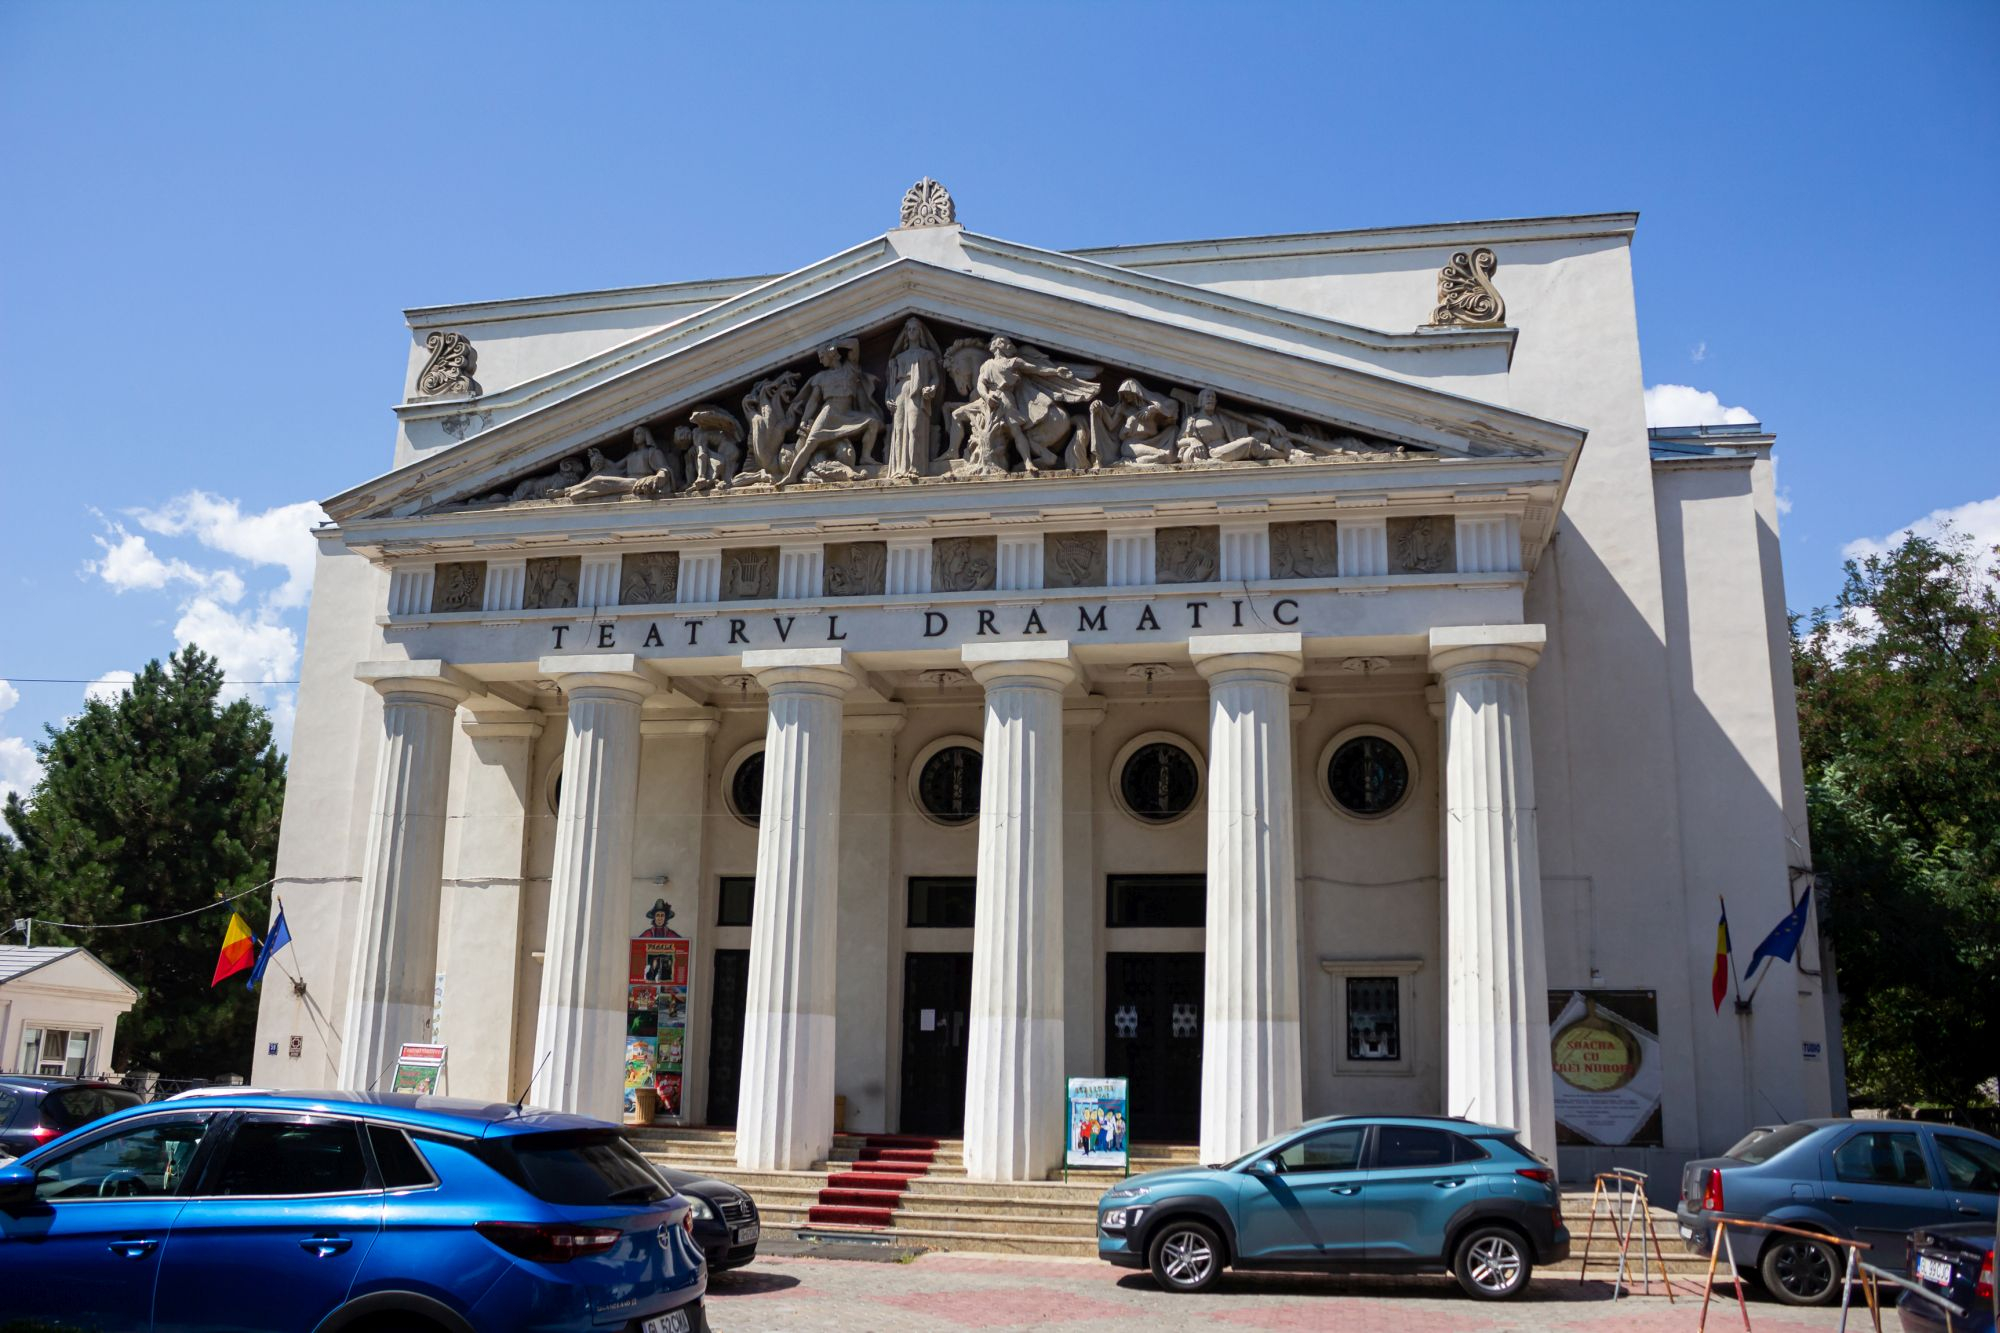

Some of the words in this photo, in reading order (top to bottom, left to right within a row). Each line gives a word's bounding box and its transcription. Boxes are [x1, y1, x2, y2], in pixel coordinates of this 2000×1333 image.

[551, 615, 848, 650] TEATRVL
[923, 598, 1300, 638] DRAMATIC
[1583, 1052, 1599, 1061] CU
